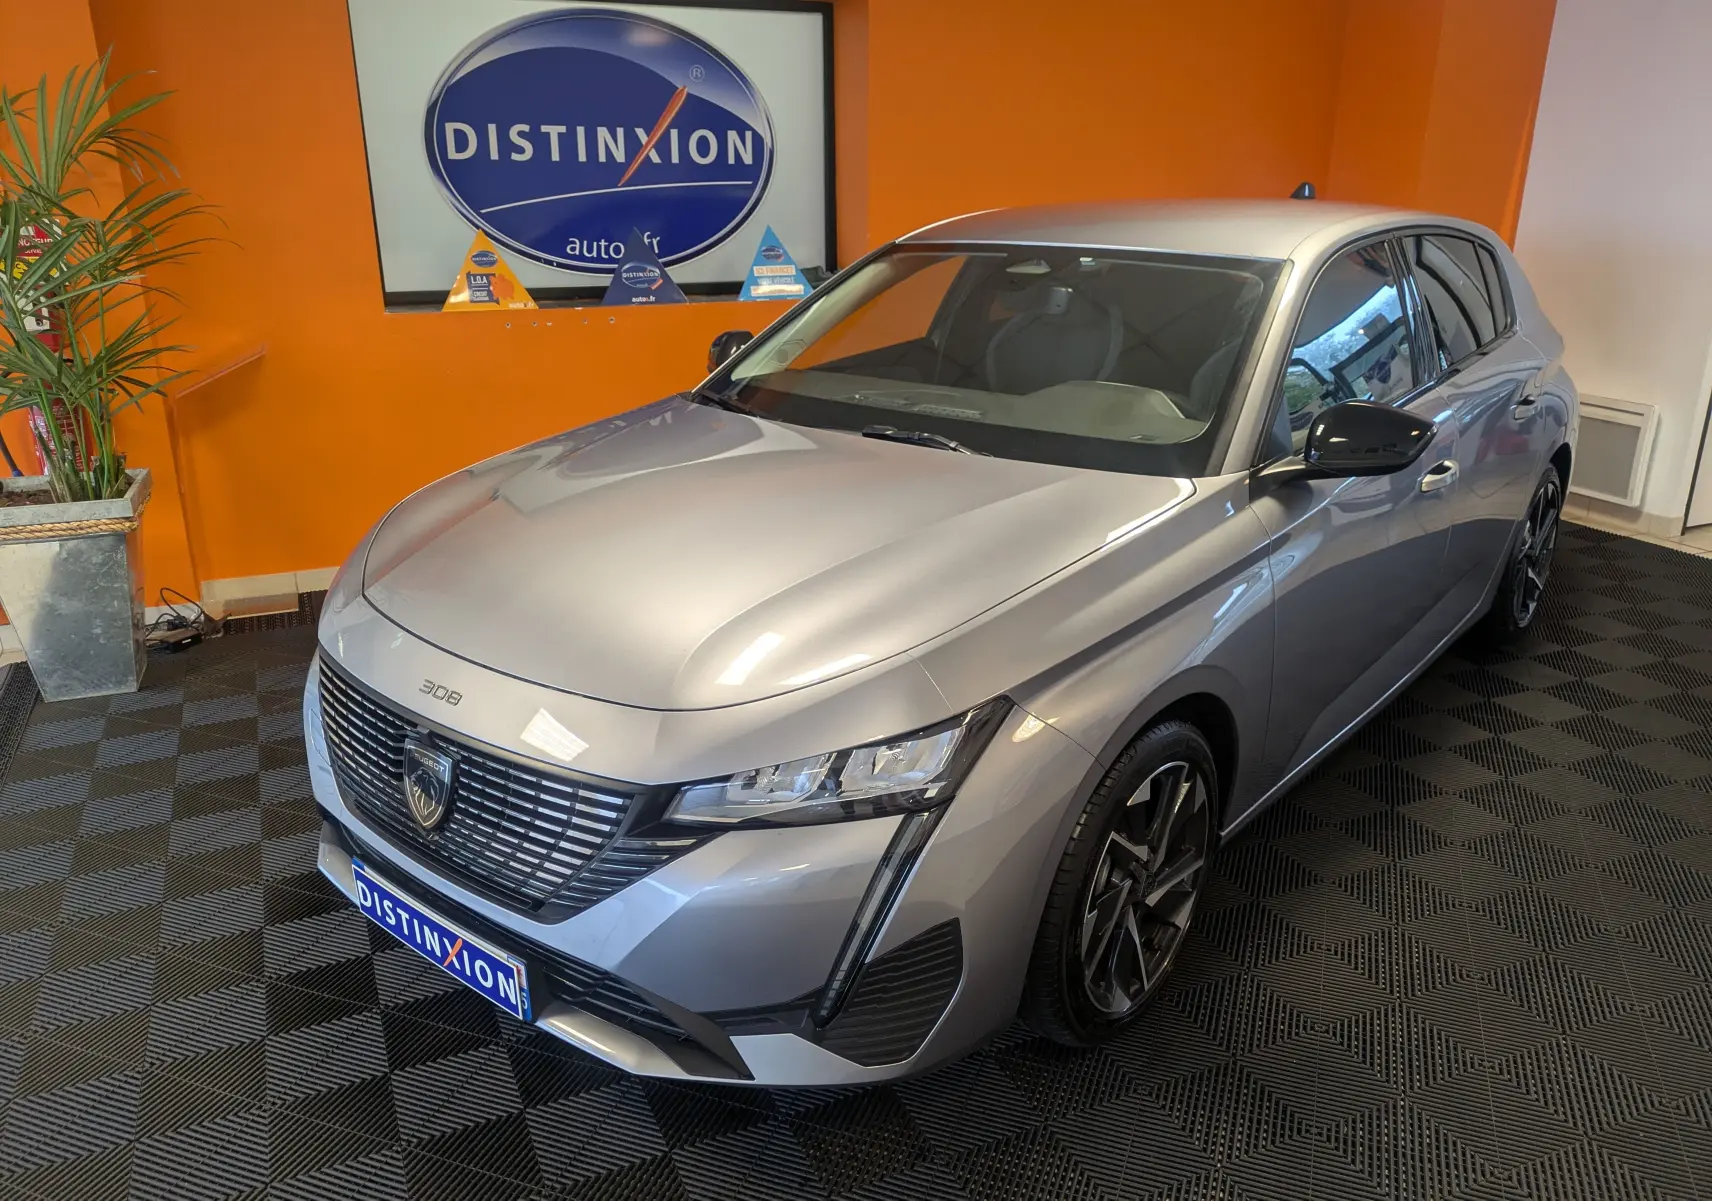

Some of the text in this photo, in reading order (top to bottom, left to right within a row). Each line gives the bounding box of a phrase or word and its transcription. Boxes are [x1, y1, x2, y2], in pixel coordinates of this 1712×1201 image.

[443, 121, 754, 166] DISTINXION
[418, 678, 463, 706] 308
[356, 879, 517, 1006] DISTINXION
